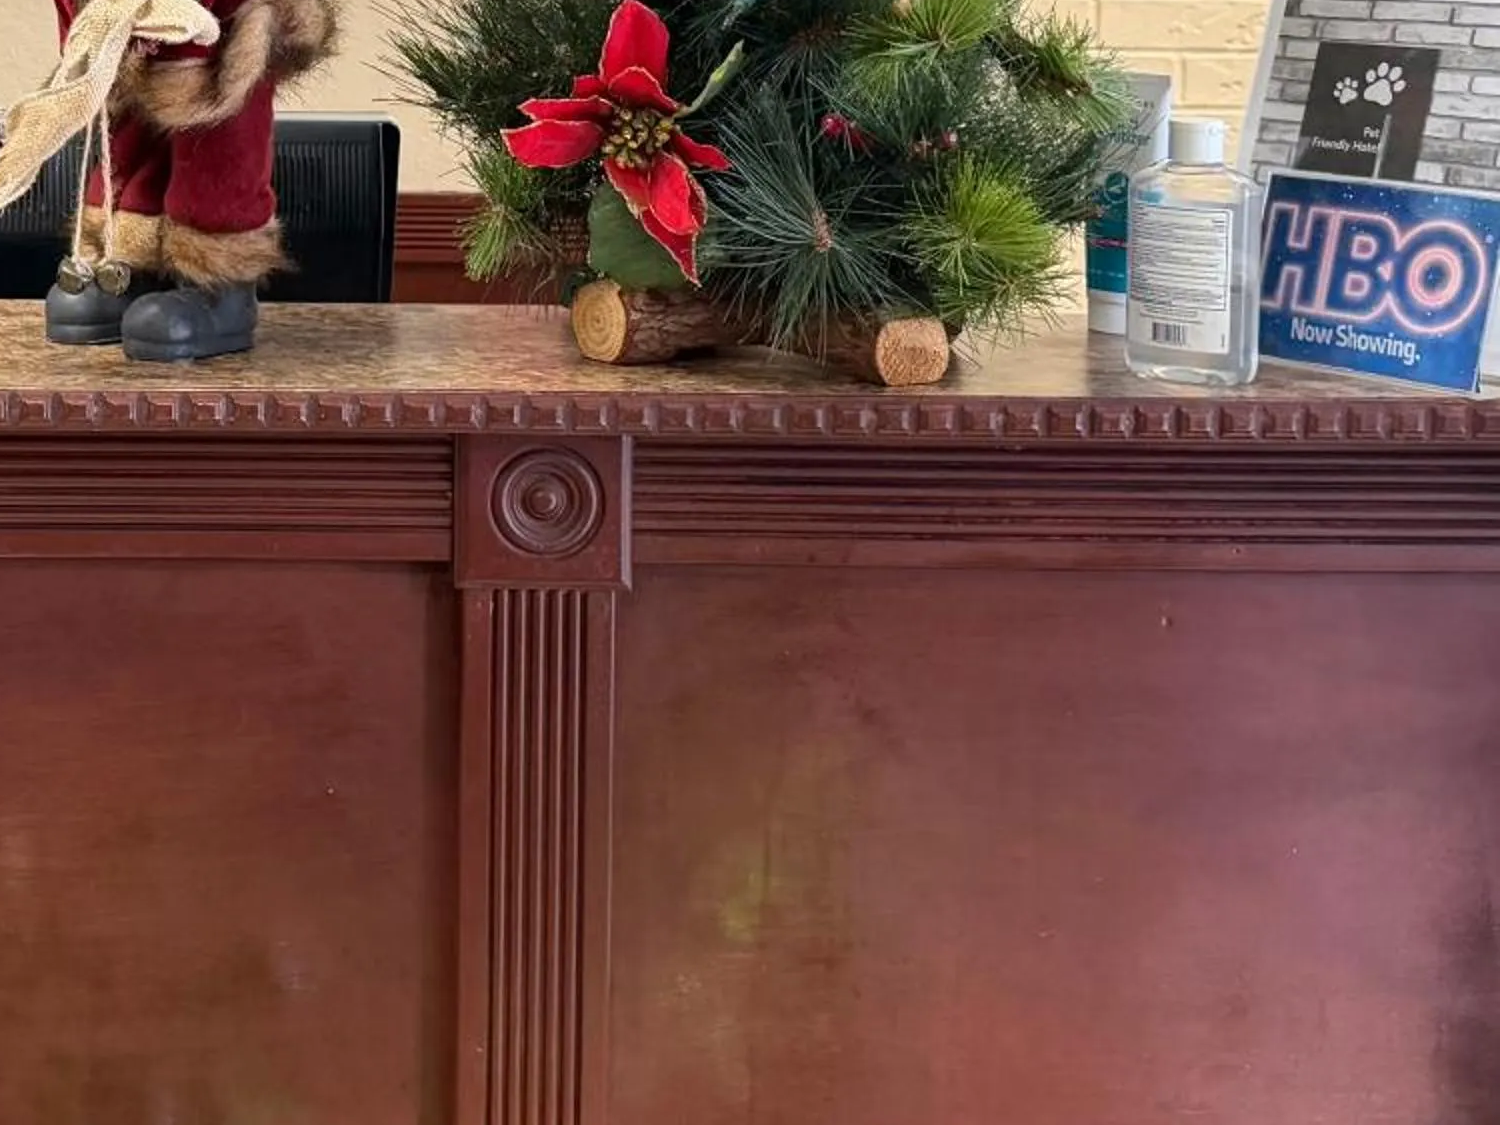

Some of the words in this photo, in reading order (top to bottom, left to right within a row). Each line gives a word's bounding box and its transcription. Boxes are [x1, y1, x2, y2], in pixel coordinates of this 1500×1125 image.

[1311, 136, 1350, 152] Friendly
[1363, 126, 1381, 139] Pet
[1260, 201, 1488, 334] HBO
[1290, 316, 1333, 345] Now
[1335, 324, 1421, 366] Showing.
